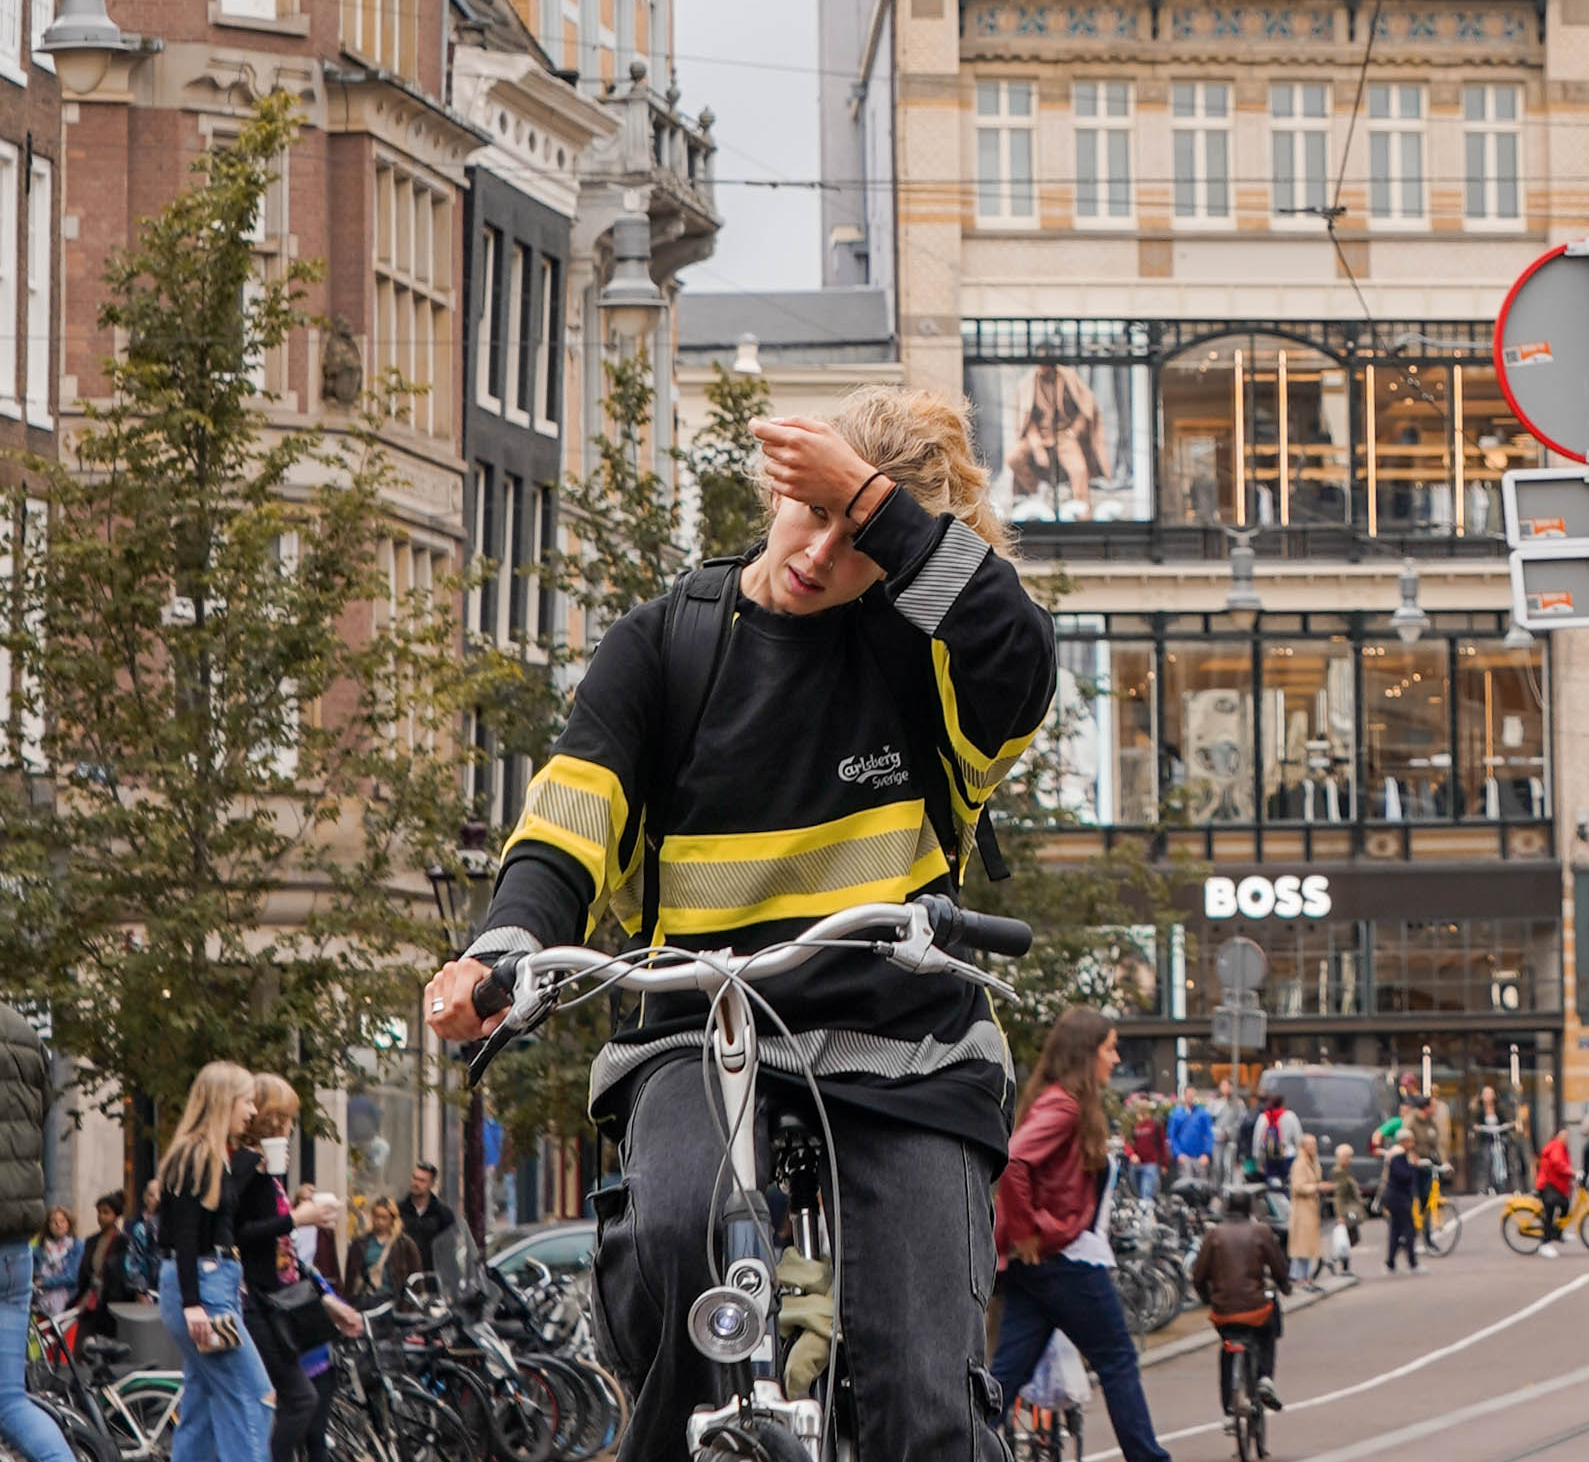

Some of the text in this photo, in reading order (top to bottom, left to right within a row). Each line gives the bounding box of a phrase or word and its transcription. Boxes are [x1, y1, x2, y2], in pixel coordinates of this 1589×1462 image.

[838, 752, 902, 784] Carlsberg
[872, 770, 909, 790] Sverige
[1204, 874, 1332, 919] BOSS
